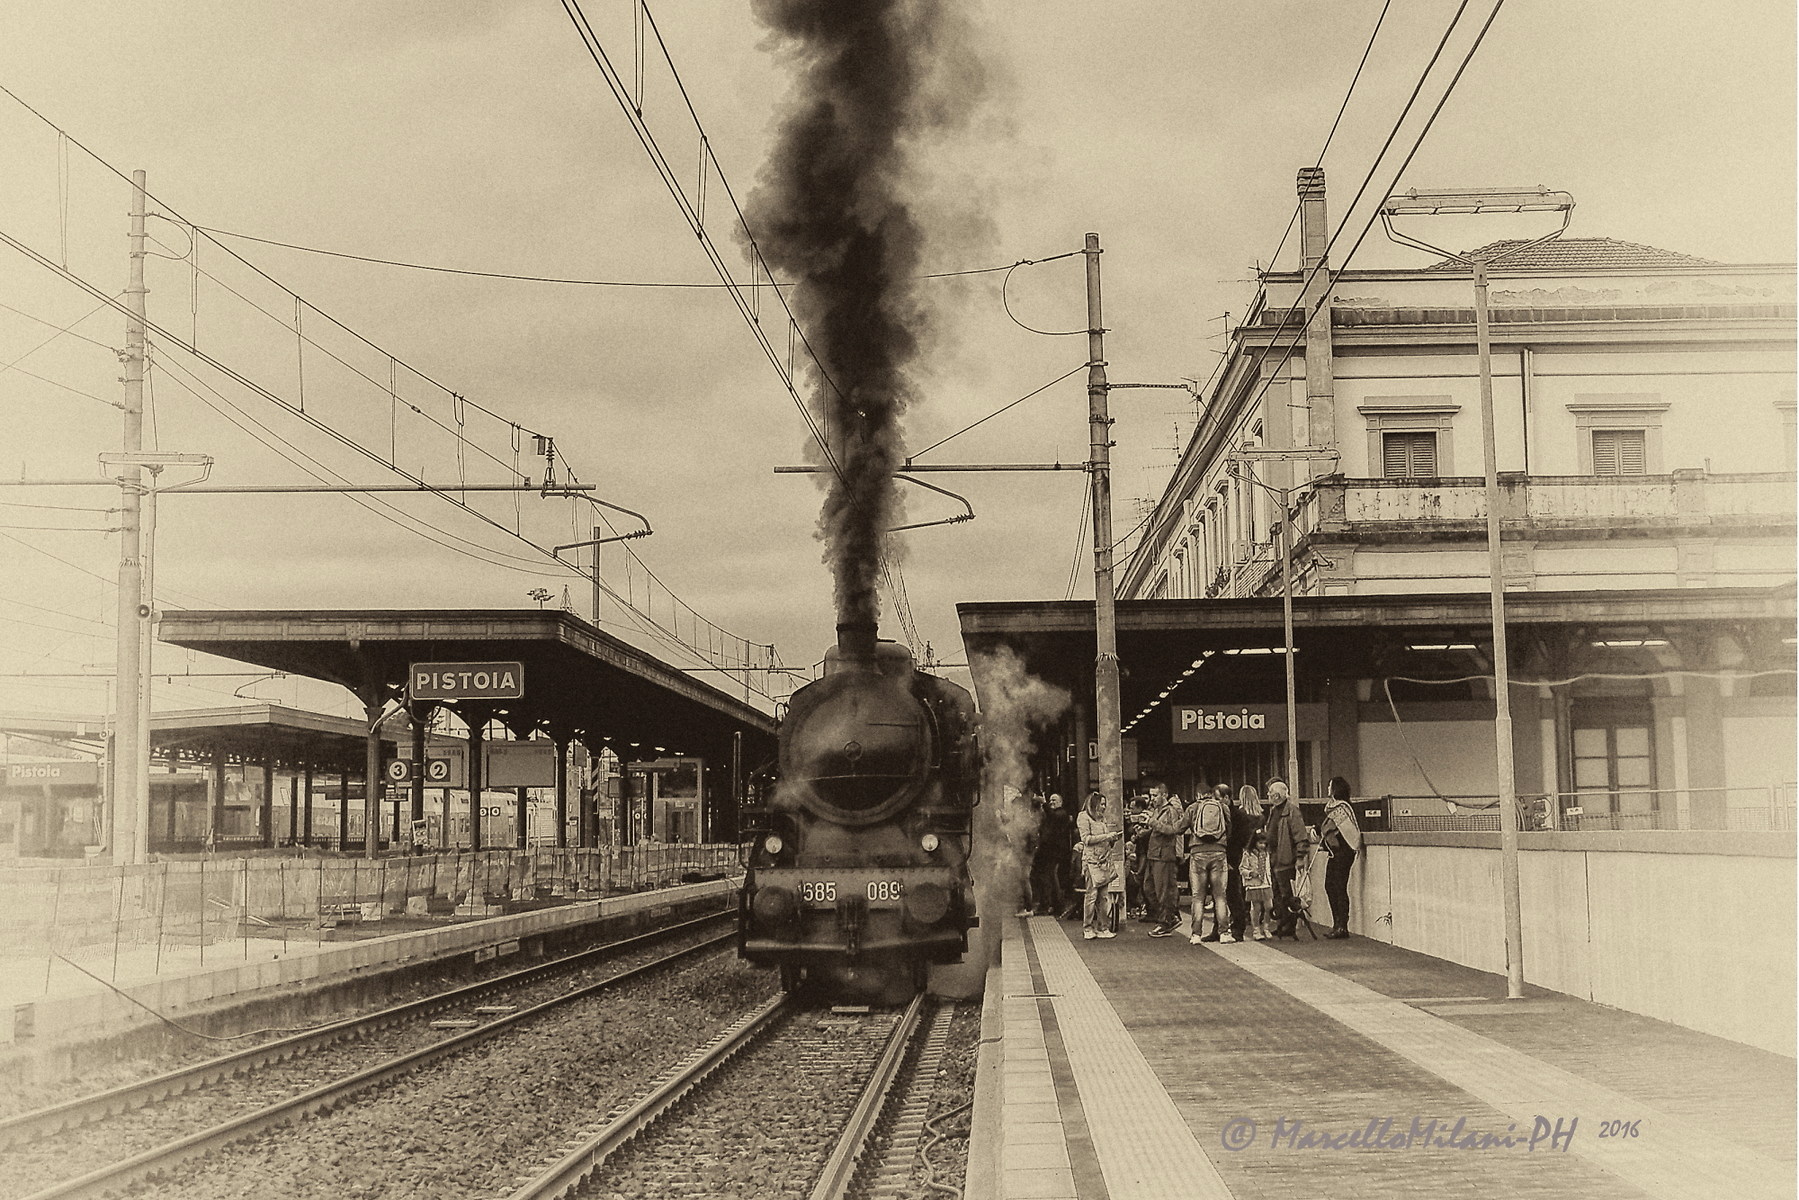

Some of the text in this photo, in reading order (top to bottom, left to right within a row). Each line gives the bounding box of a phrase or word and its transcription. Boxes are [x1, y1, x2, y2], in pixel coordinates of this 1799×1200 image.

[416, 671, 516, 690] PISTOIA
[1180, 708, 1265, 730] Pistoia
[12, 764, 60, 778] Pistoia
[393, 764, 403, 777] 3
[433, 764, 444, 777] 2
[867, 881, 900, 901] 089
